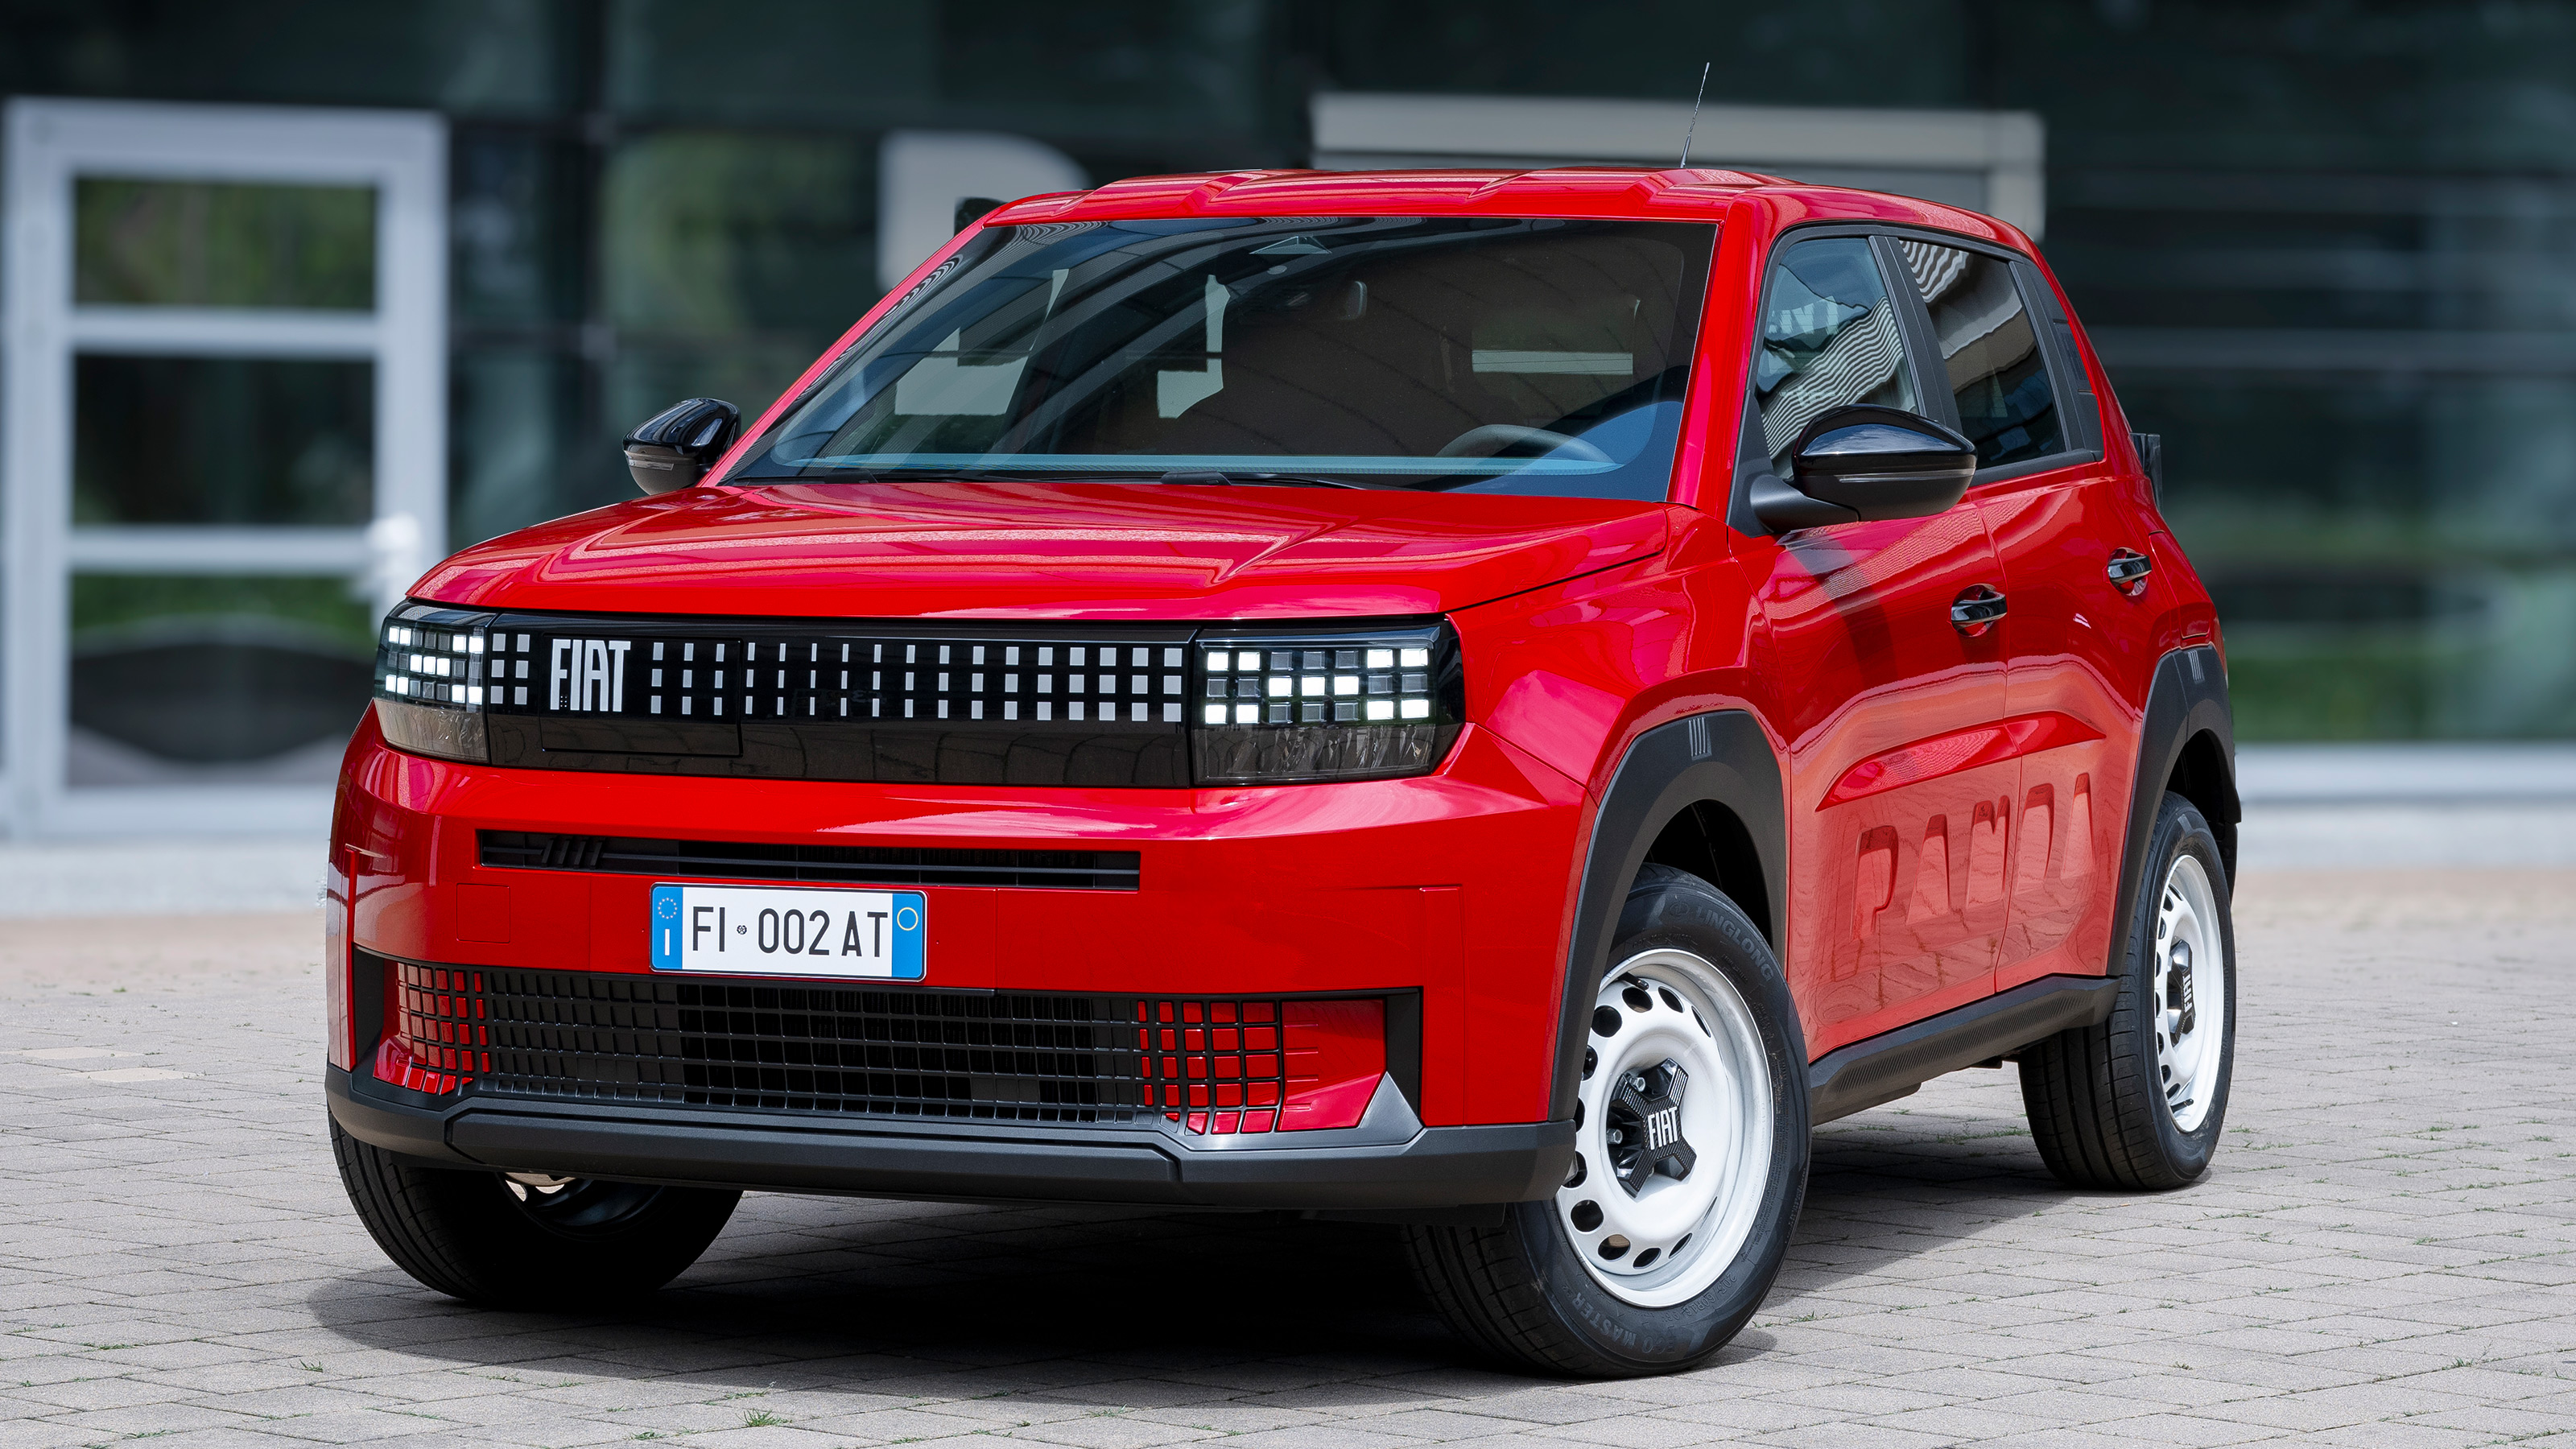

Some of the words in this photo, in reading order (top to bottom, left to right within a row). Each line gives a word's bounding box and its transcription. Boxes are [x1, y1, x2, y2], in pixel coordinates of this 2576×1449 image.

[550, 638, 631, 712] FIAT
[1850, 771, 2096, 934] PANDA
[664, 927, 671, 956] I
[692, 906, 726, 952] FI
[758, 908, 831, 956] 002
[841, 910, 889, 958] AT
[1695, 906, 1774, 982] LINGLONG
[2182, 973, 2193, 1013] FIAT
[1647, 1106, 1678, 1150] FIAT
[1571, 1291, 1637, 1350] MASTER
